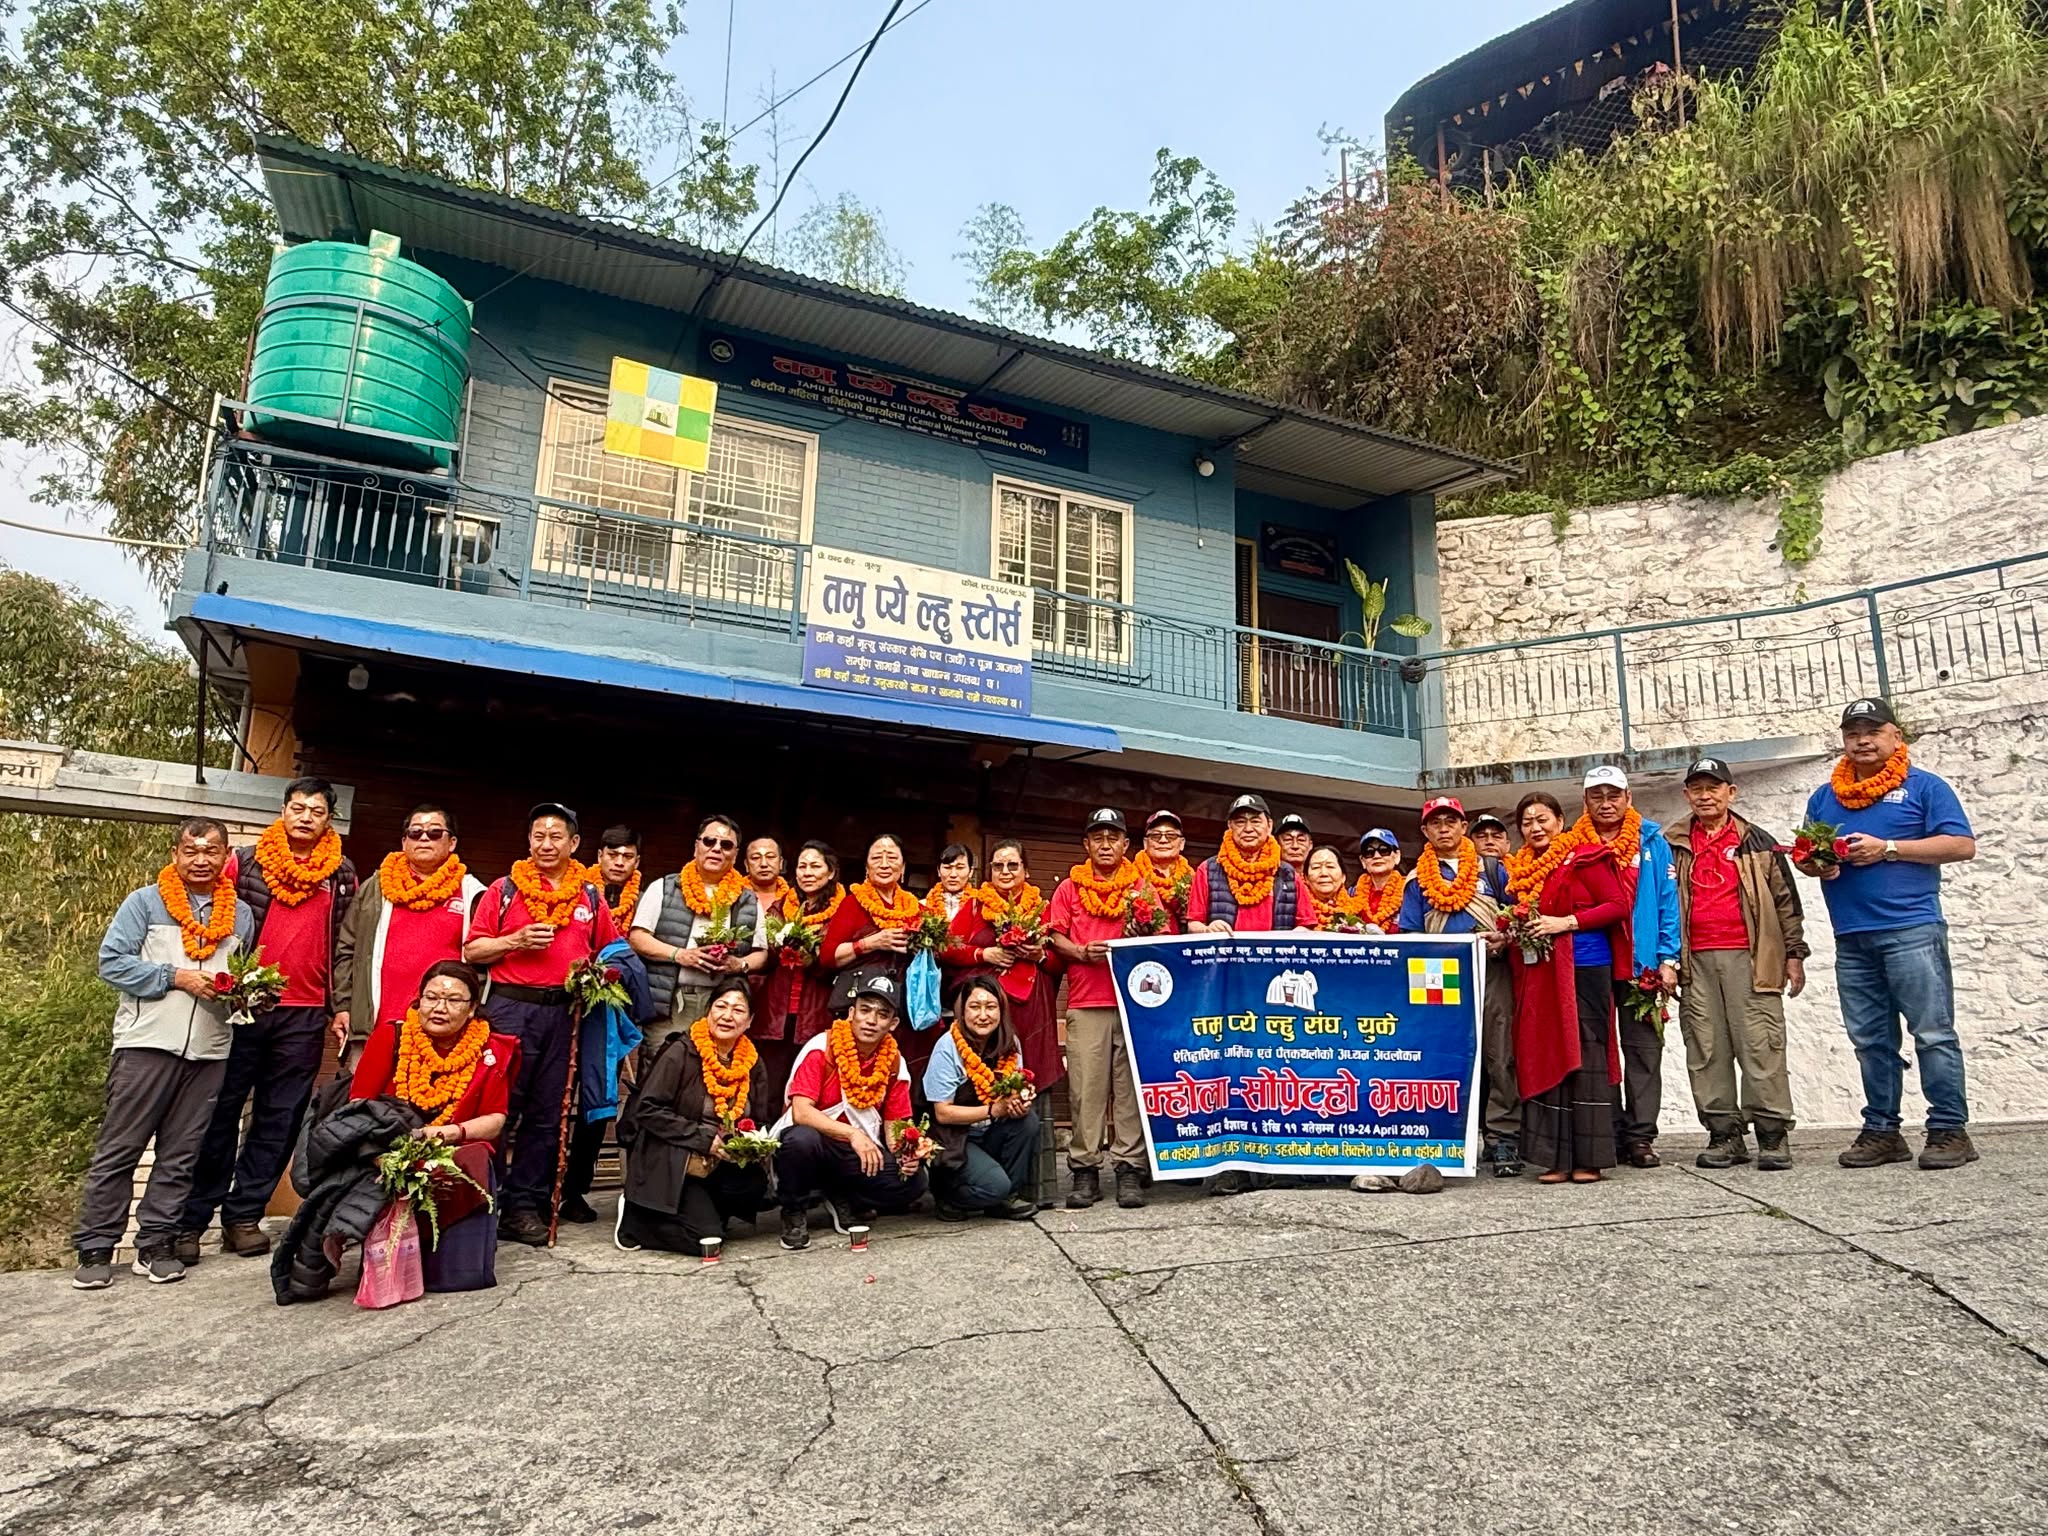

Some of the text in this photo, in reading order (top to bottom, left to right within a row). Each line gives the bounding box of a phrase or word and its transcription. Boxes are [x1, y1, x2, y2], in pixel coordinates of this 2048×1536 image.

[797, 380, 825, 392] TAMU
[828, 387, 877, 404] RELIGIOUS
[890, 401, 936, 418] CULTURAL
[940, 414, 1008, 436] ORGANIZATION
[908, 415, 941, 430] (Central
[943, 424, 973, 438] Women
[975, 432, 1017, 448] Committee
[1019, 443, 1047, 456] Office)
[823, 574, 1022, 647] तमु प्ये ल्हु स्टोर्स
[969, 658, 975, 667] र
[1191, 1014, 1224, 1042] तमु
[1228, 1010, 1258, 1033] प्ये
[1265, 1015, 1297, 1042] ल्हु
[1357, 1012, 1399, 1043] युके
[1369, 1078, 1460, 1117] भ्रमण
[1261, 1119, 1281, 1134] देखि
[1338, 1123, 1371, 1137] (19-24
[1372, 1124, 1398, 1137] April
[1400, 1124, 1429, 1138] 2026)
